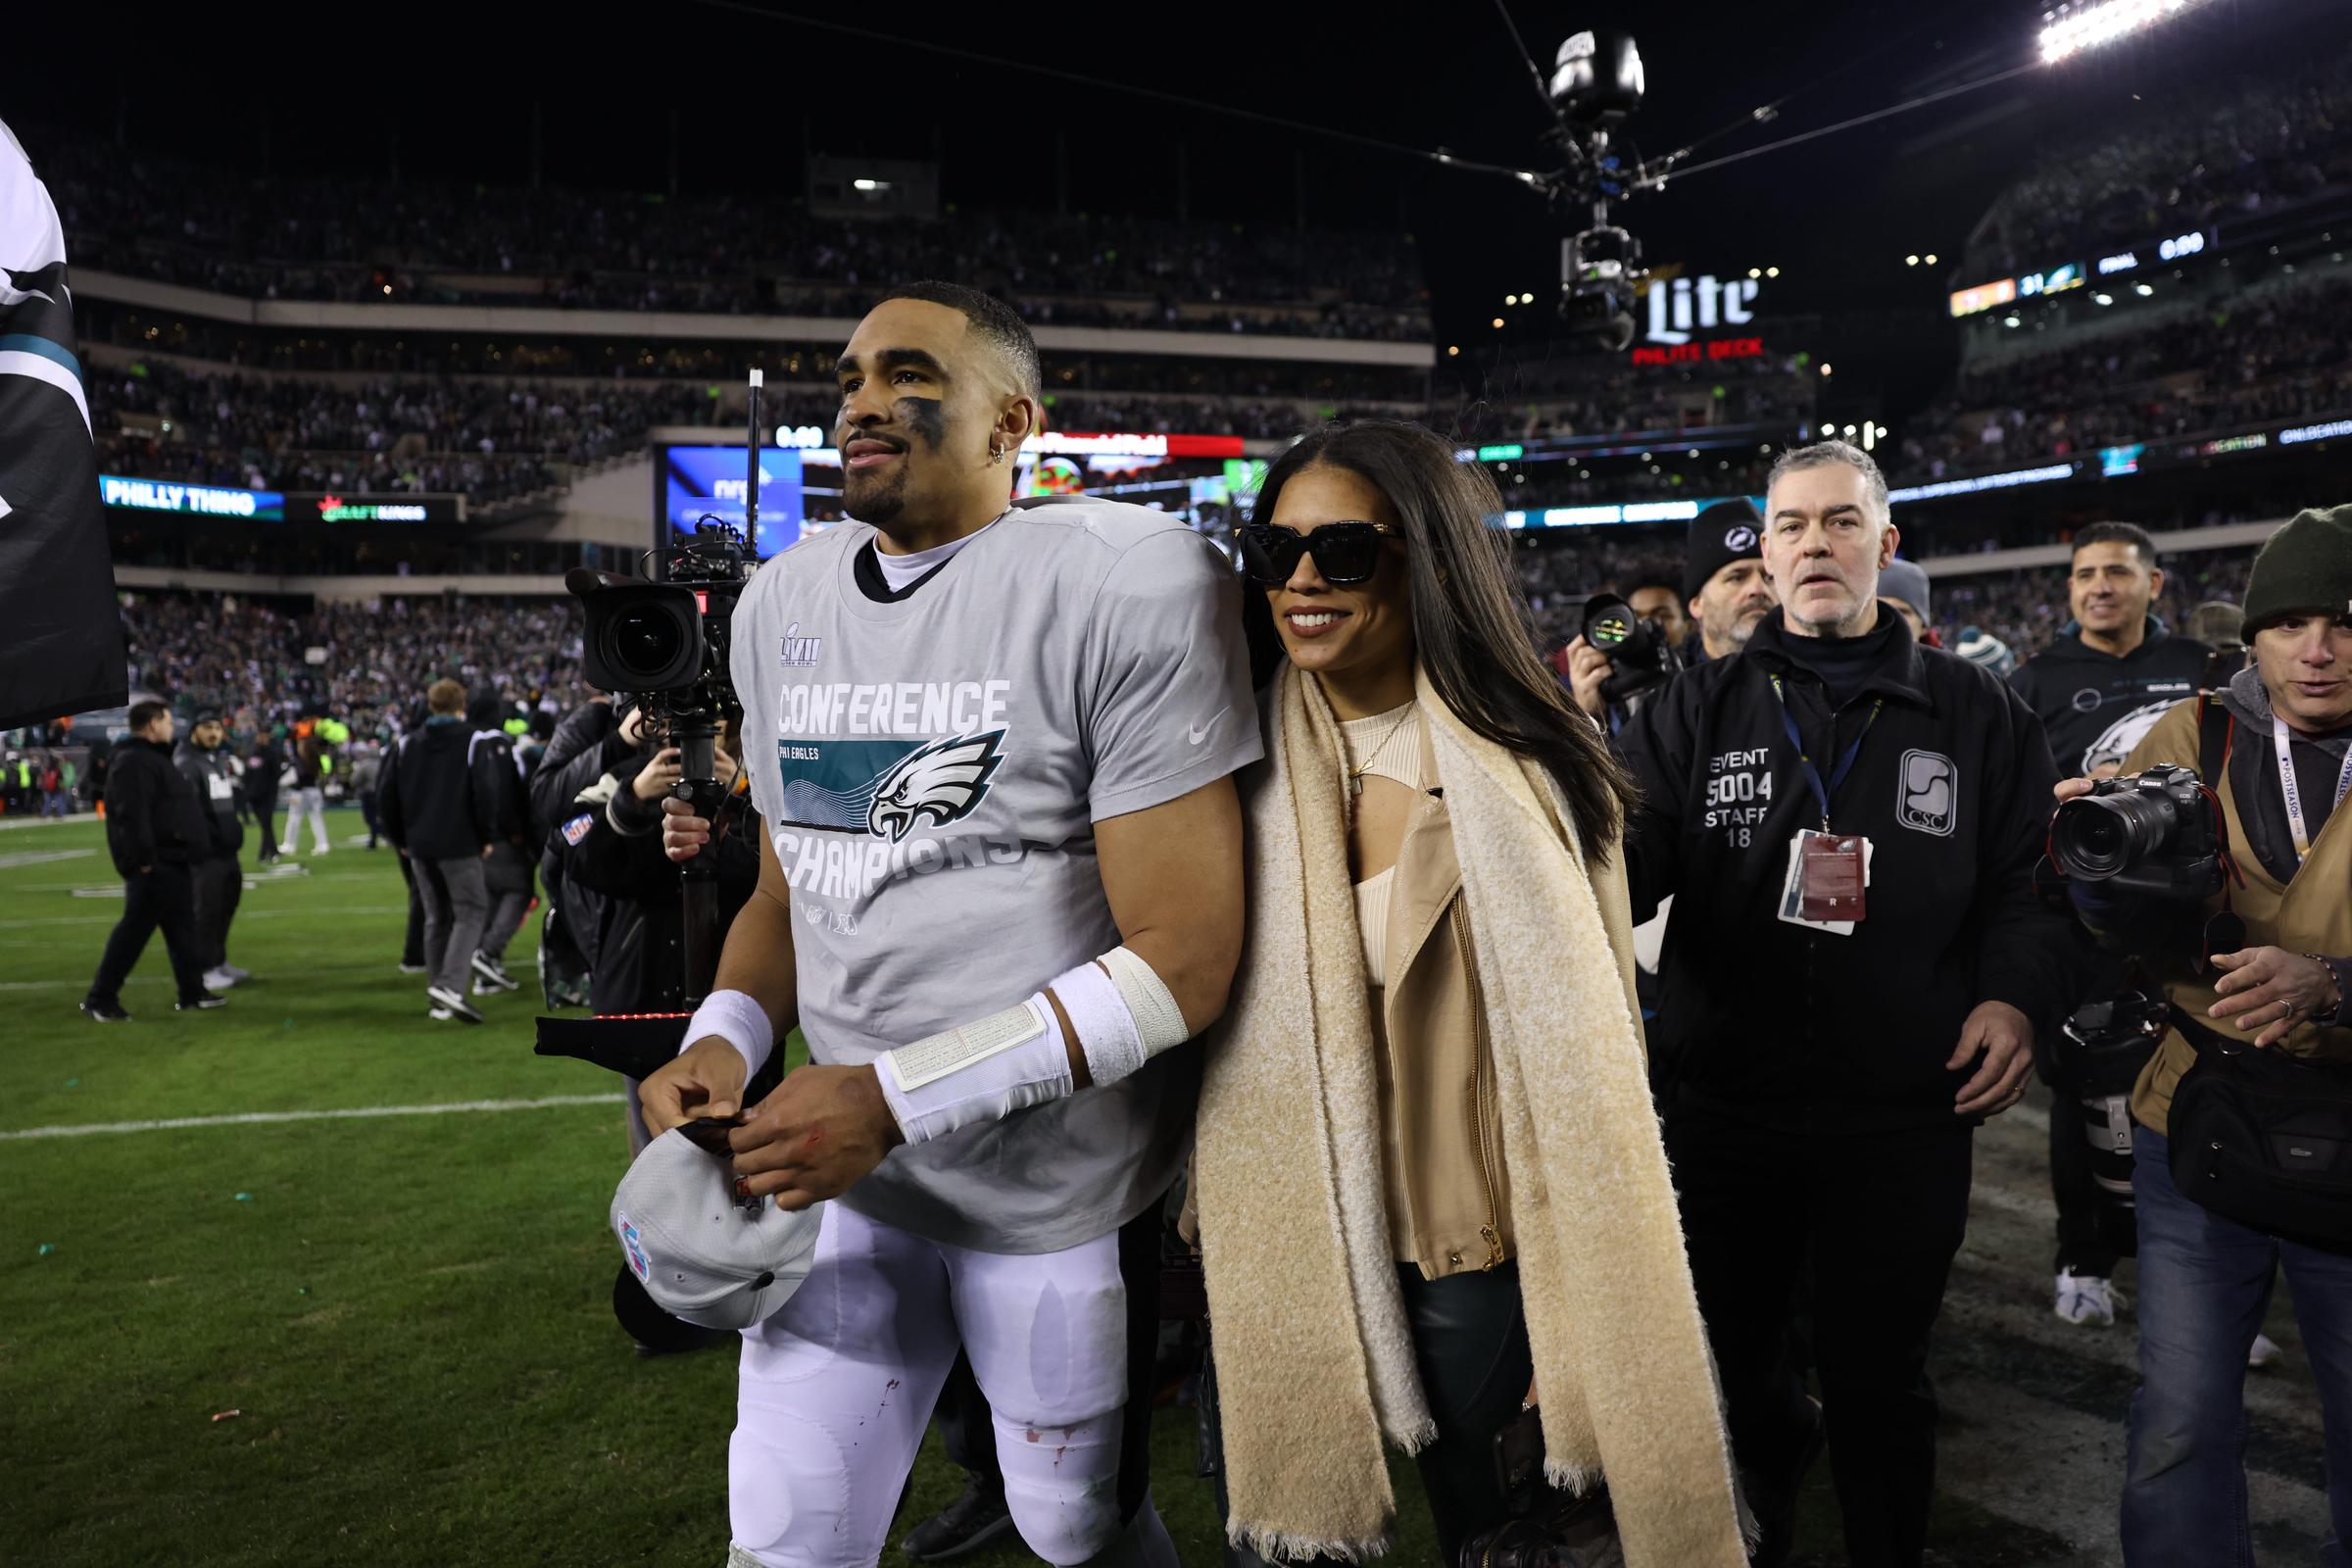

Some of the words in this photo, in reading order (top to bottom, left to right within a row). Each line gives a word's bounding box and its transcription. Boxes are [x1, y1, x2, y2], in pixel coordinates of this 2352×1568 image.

[1646, 274, 1758, 345] Lite
[106, 478, 184, 511] PHILLY
[186, 487, 257, 516] THING
[778, 680, 1010, 734] CONFERENCE
[779, 746, 790, 759] PHI
[791, 747, 819, 760] EAGLES
[1710, 748, 1769, 773] EVENT
[1705, 771, 1772, 808] 5004
[2282, 766, 2300, 819] POSTSEASON
[1704, 807, 1768, 828] STAFF
[1908, 809, 1943, 829] CSC
[1726, 828, 1752, 848] 18
[1829, 898, 1837, 906] R
